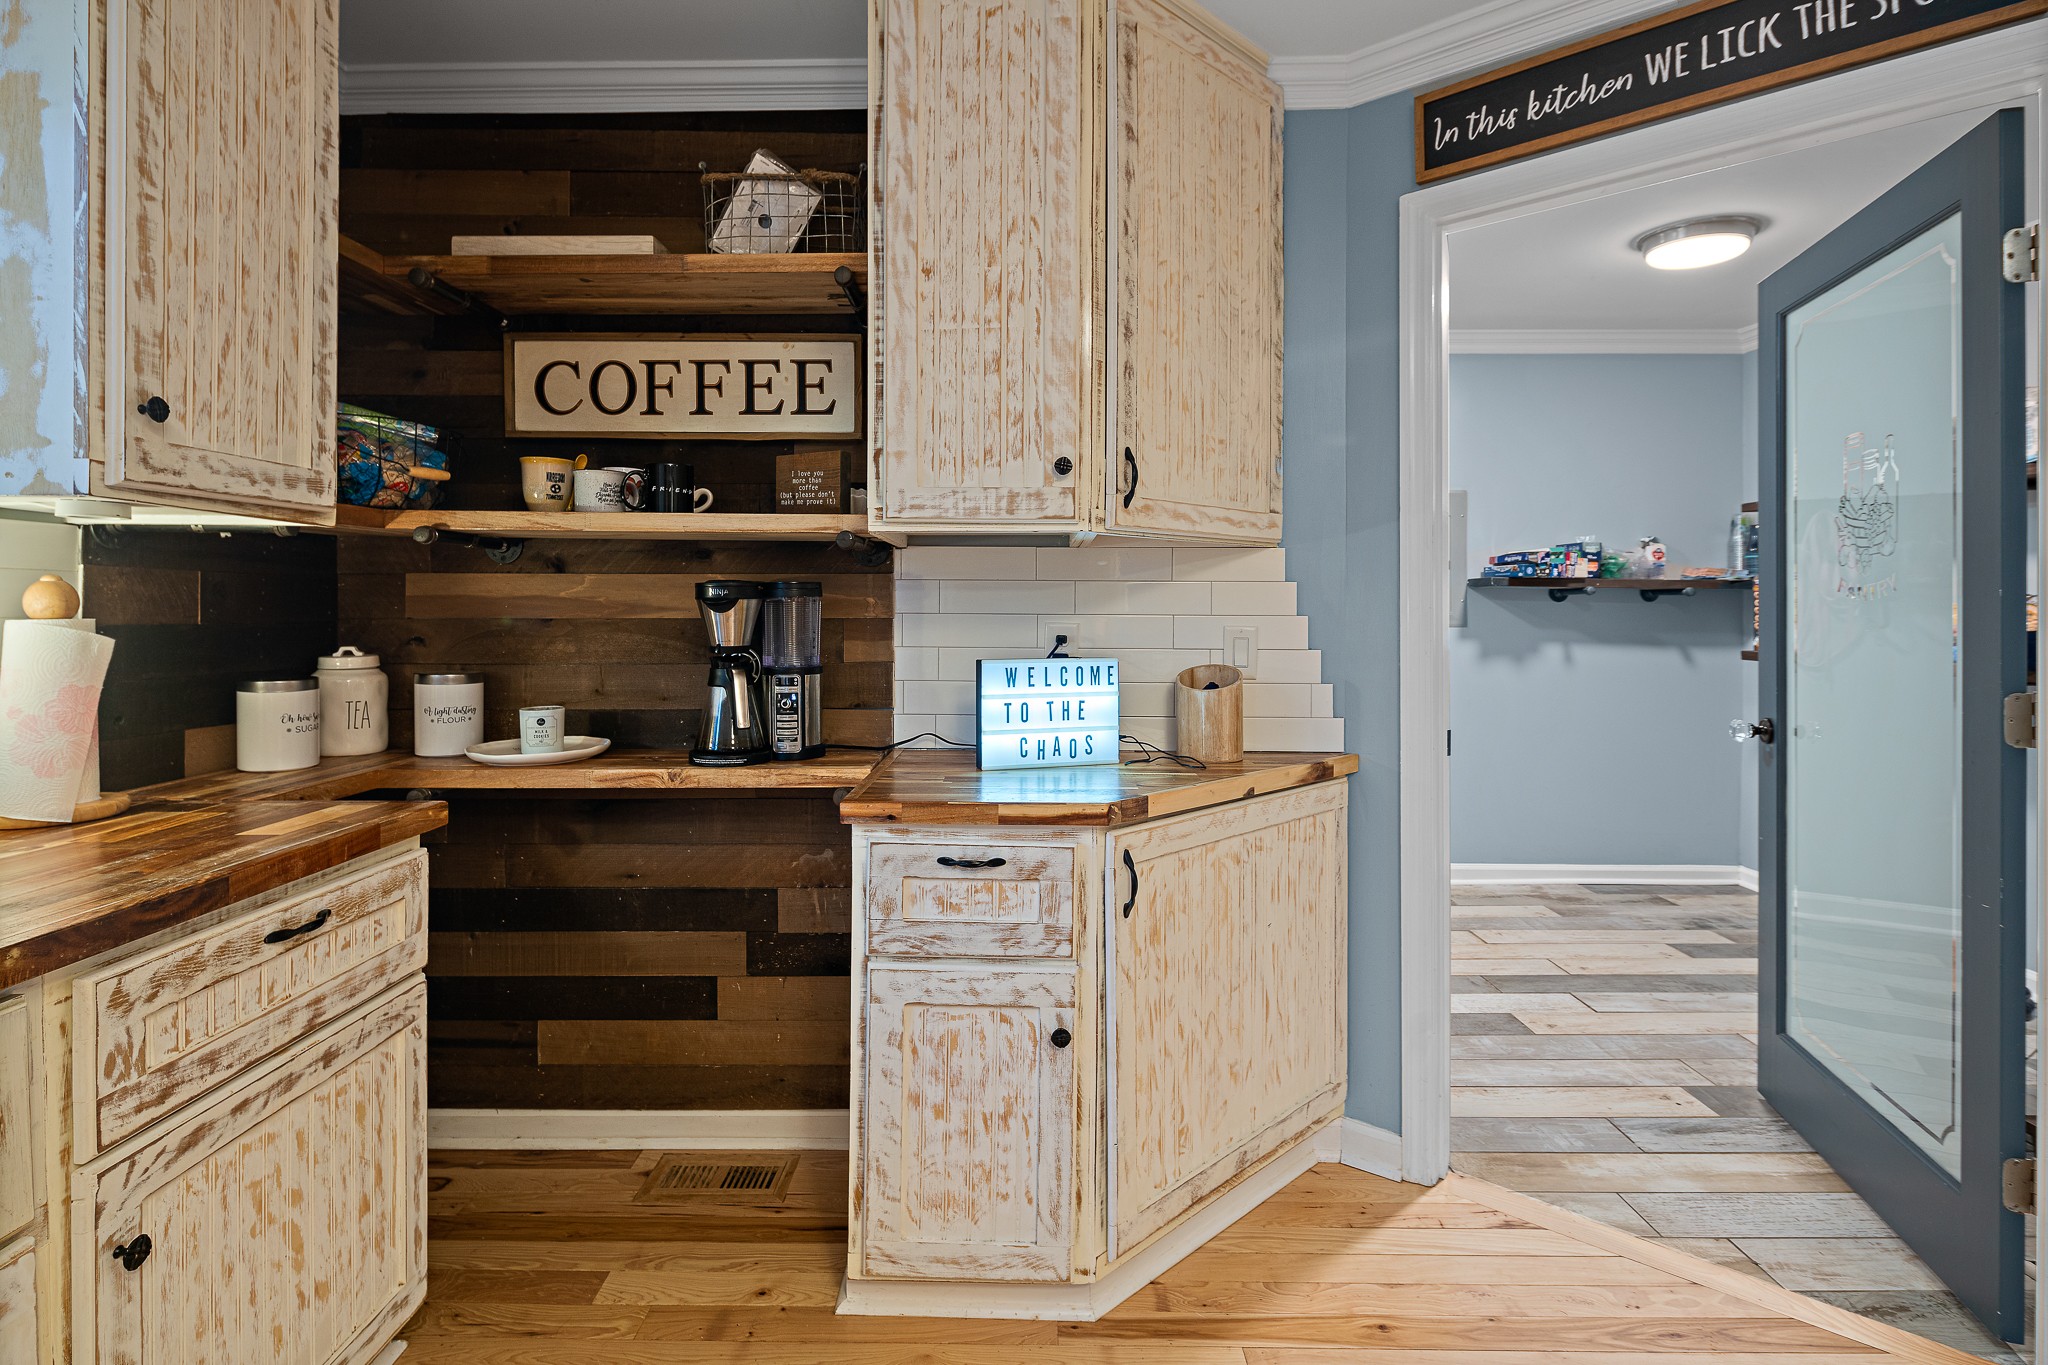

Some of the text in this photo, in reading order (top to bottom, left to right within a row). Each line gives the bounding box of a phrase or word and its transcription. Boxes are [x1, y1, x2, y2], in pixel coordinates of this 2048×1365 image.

[1433, 117, 1459, 150] In
[1466, 105, 1518, 140] this
[1526, 72, 1633, 120] kitchen
[1644, 41, 1690, 86] WE
[1701, 12, 1782, 70] LICK
[1792, 0, 1858, 40] THE
[534, 359, 837, 416] COFFEE
[813, 470, 824, 478] you
[780, 490, 835, 499] (but please don't
[708, 587, 729, 597] NINJA
[1005, 665, 1115, 688] WELCOME
[345, 700, 371, 730] TEA
[436, 716, 466, 724] FLOUR
[1004, 700, 1085, 723] TO THE
[1020, 734, 1093, 760] CHAOS
